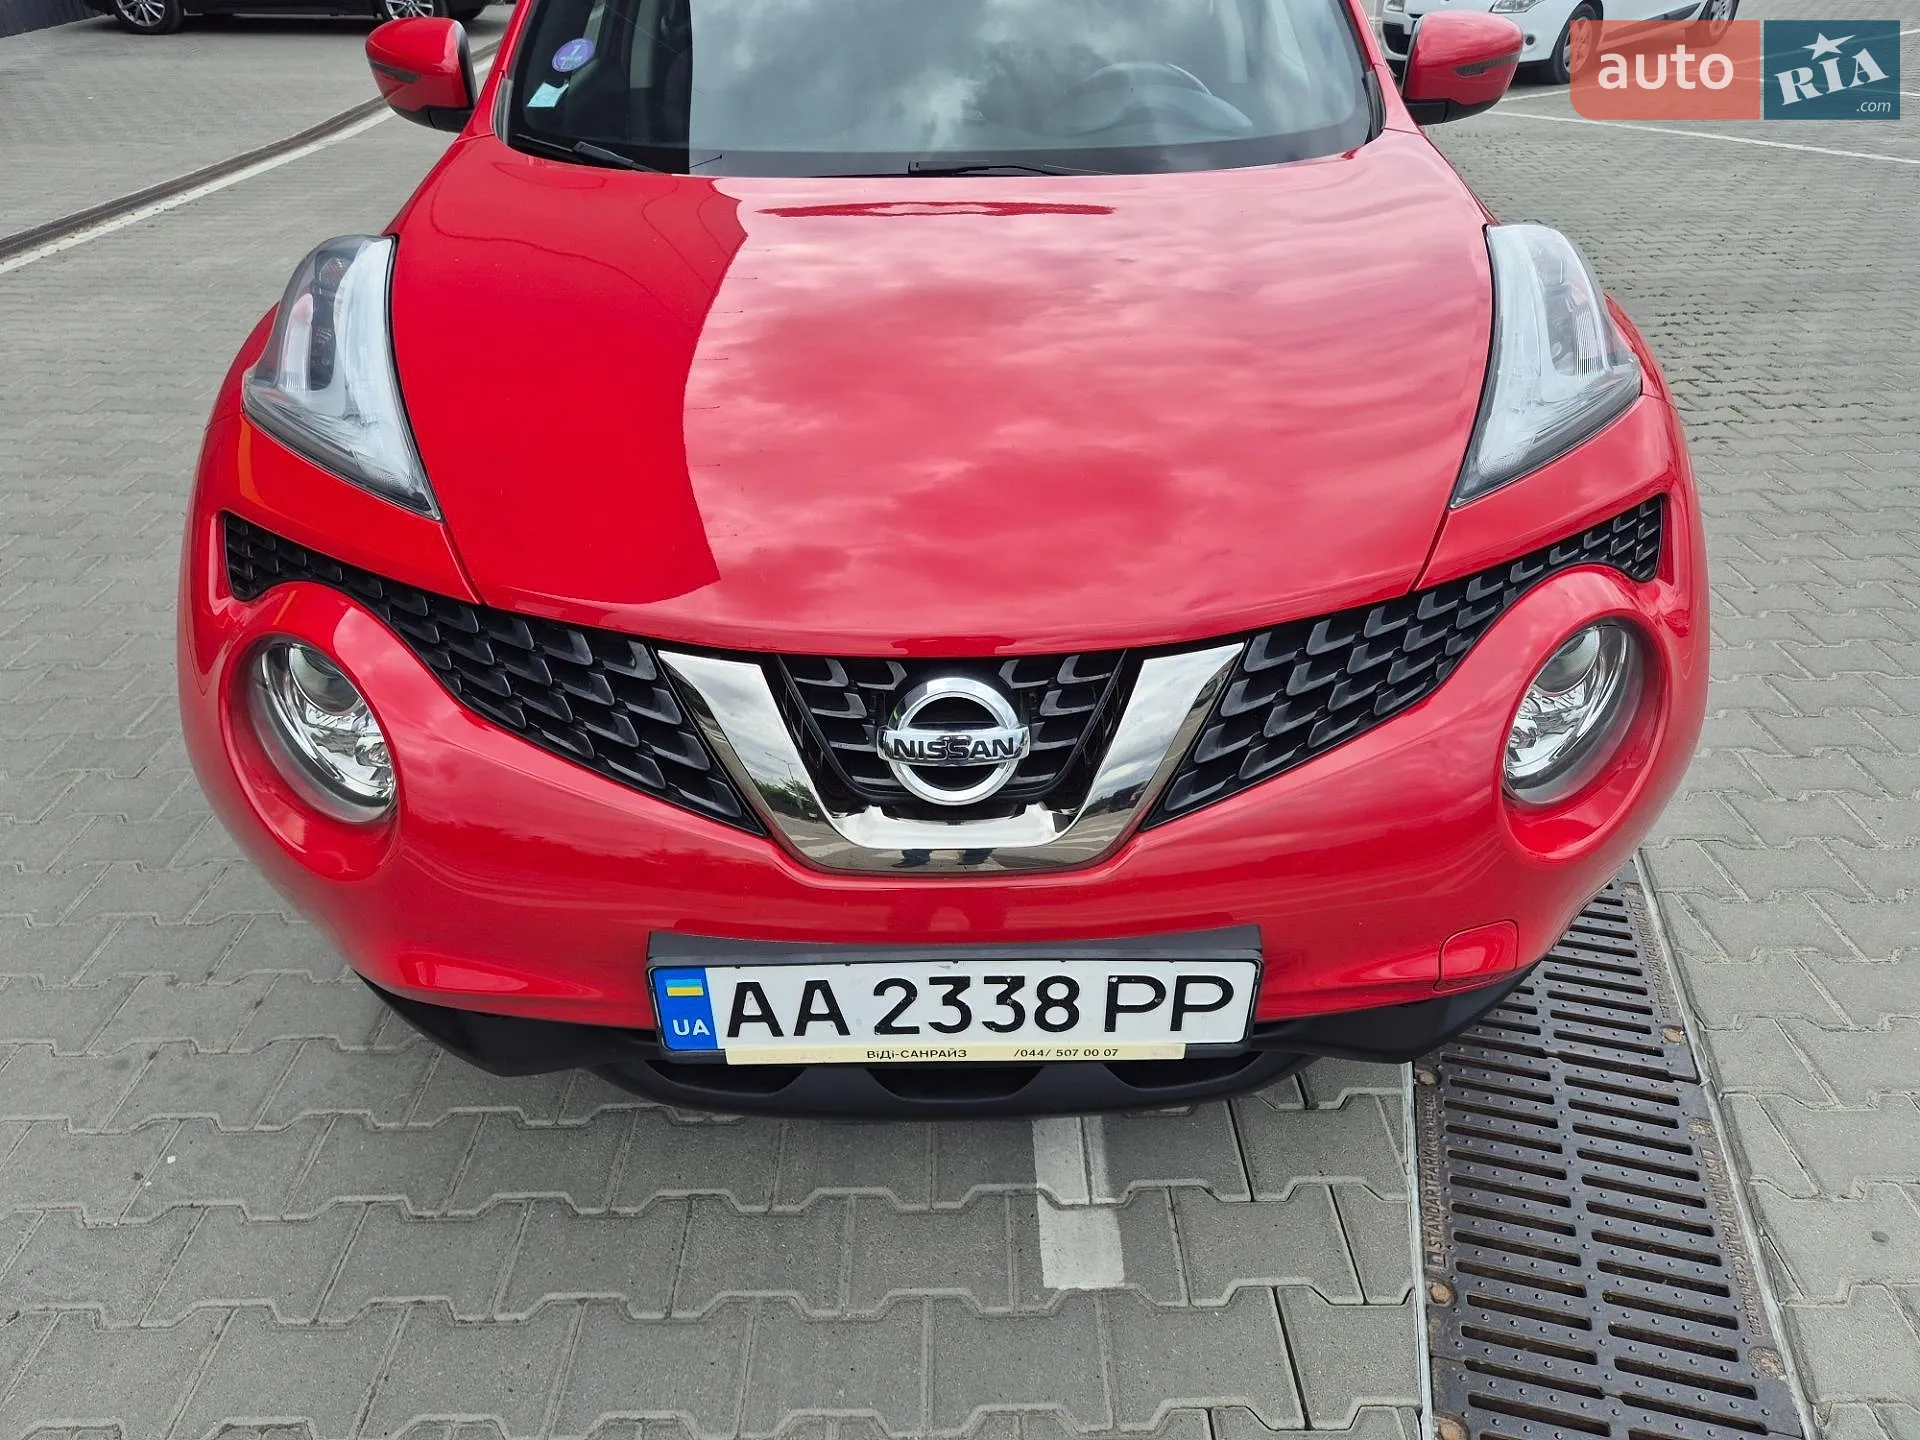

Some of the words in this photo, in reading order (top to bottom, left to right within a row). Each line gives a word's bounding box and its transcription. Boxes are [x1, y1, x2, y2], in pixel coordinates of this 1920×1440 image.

[893, 737, 1014, 760] NISSAN
[727, 980, 851, 1038] AA
[873, 975, 1080, 1035] 2338
[1104, 975, 1235, 1033] PP
[673, 1019, 711, 1036] UA
[1013, 1048, 1051, 1058] /044/
[1055, 1048, 1079, 1057] 507
[1083, 1048, 1100, 1057] 00
[1103, 1048, 1119, 1057] 07
